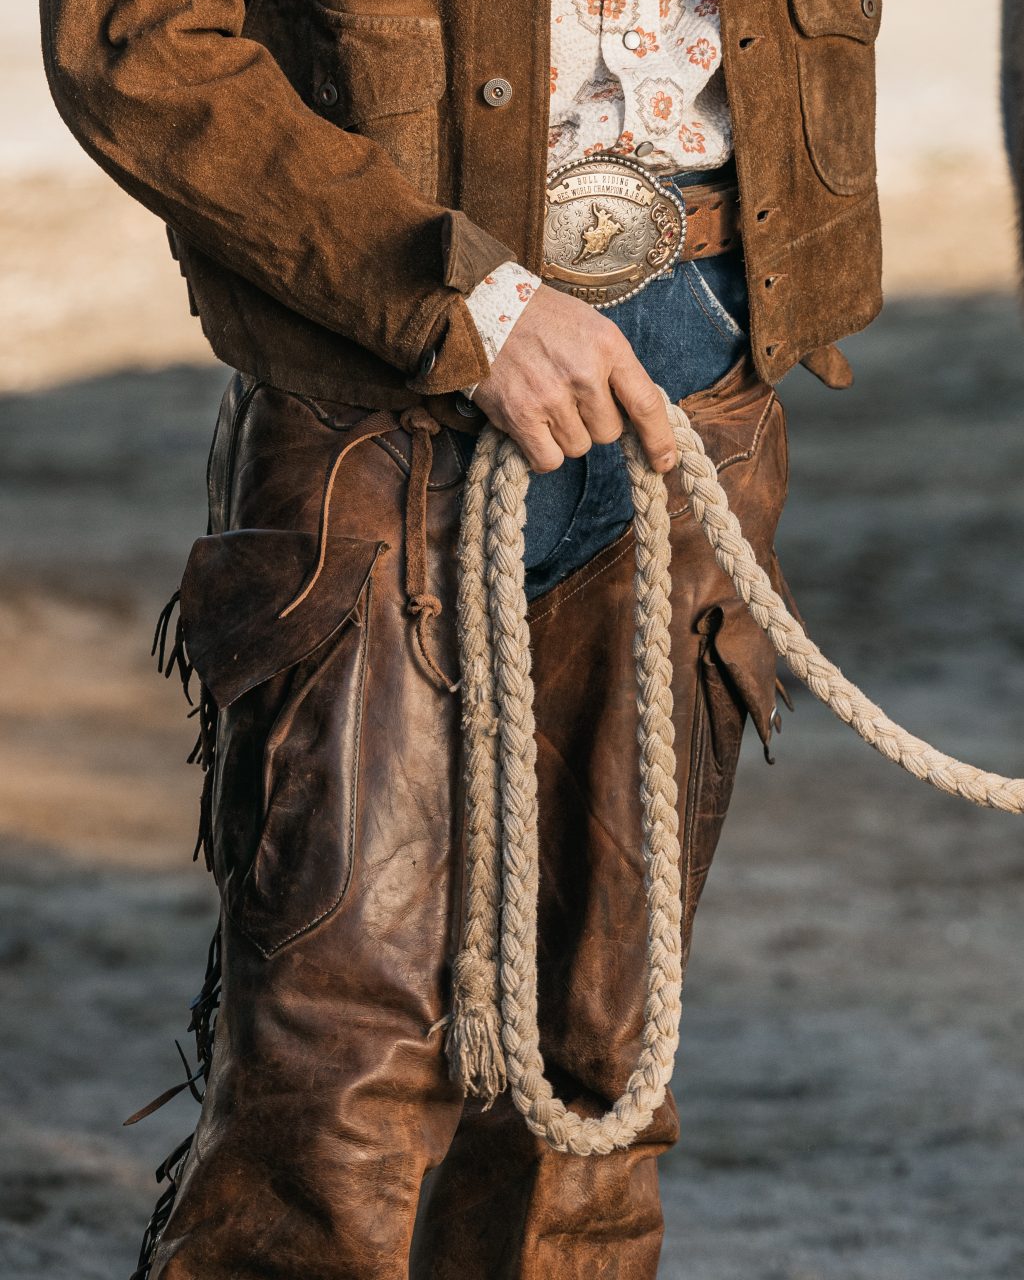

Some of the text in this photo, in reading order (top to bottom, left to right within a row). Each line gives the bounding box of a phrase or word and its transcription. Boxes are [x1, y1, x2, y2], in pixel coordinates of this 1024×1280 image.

[577, 176, 629, 186] BULL RIDING
[571, 186, 591, 196] WORLD
[594, 185, 623, 195] CHAMPION
